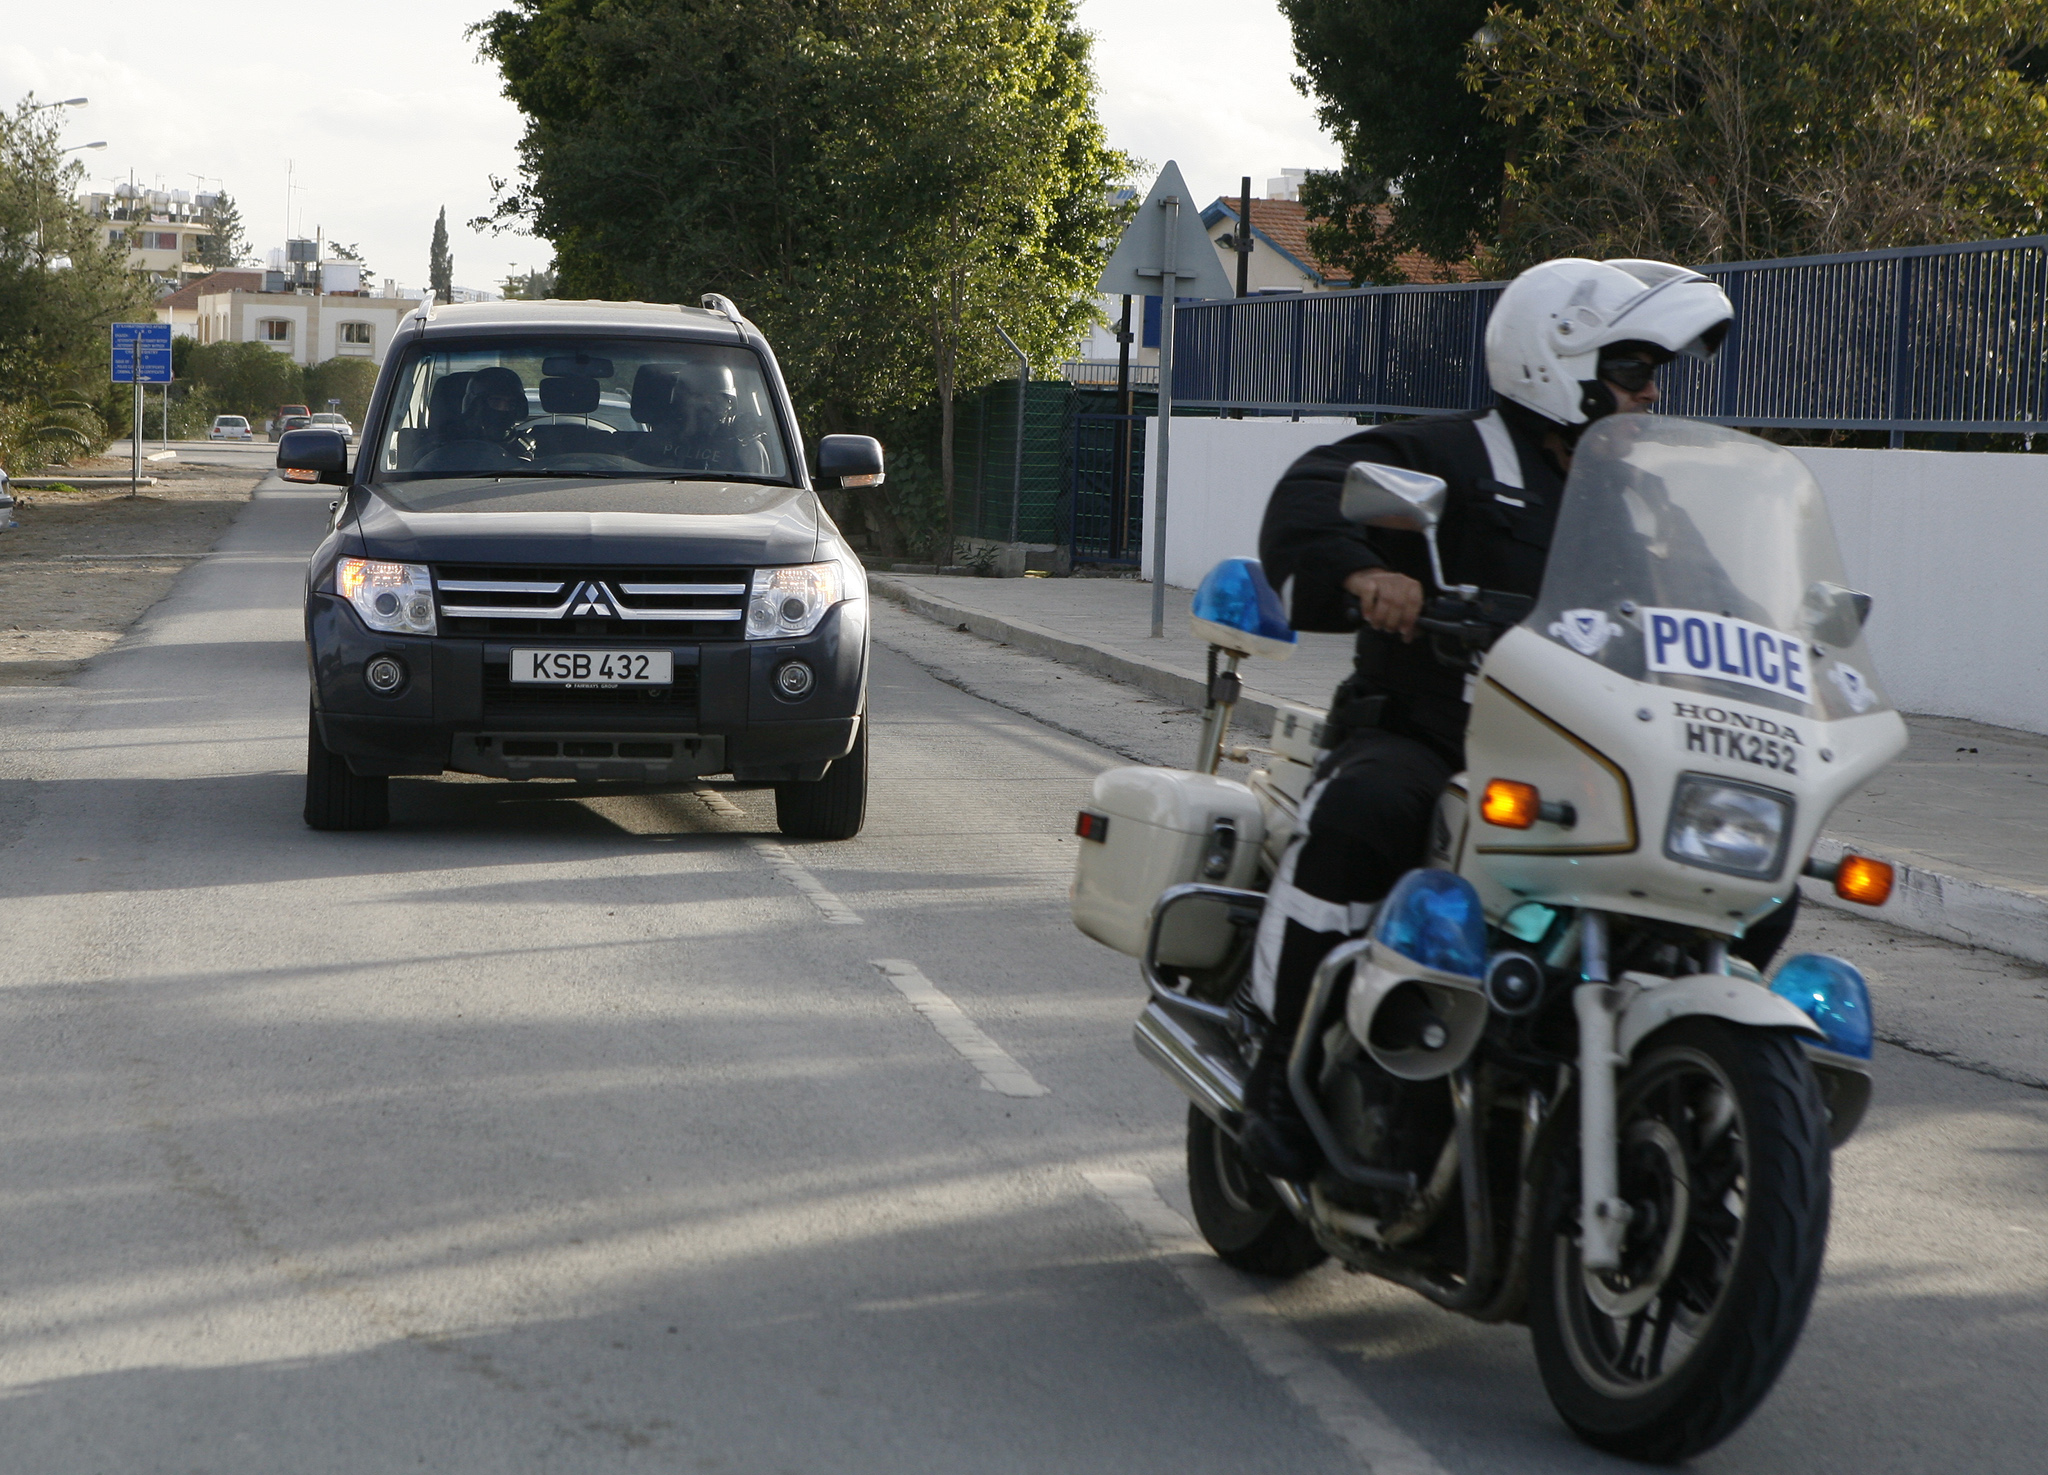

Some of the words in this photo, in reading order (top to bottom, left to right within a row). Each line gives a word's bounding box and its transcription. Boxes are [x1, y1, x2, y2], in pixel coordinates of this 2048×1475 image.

[533, 653, 591, 679] KSB
[599, 654, 650, 680] 432
[1651, 614, 1806, 696] POLICE
[1673, 702, 1804, 746] HONDA
[1686, 722, 1798, 775] HTK252
